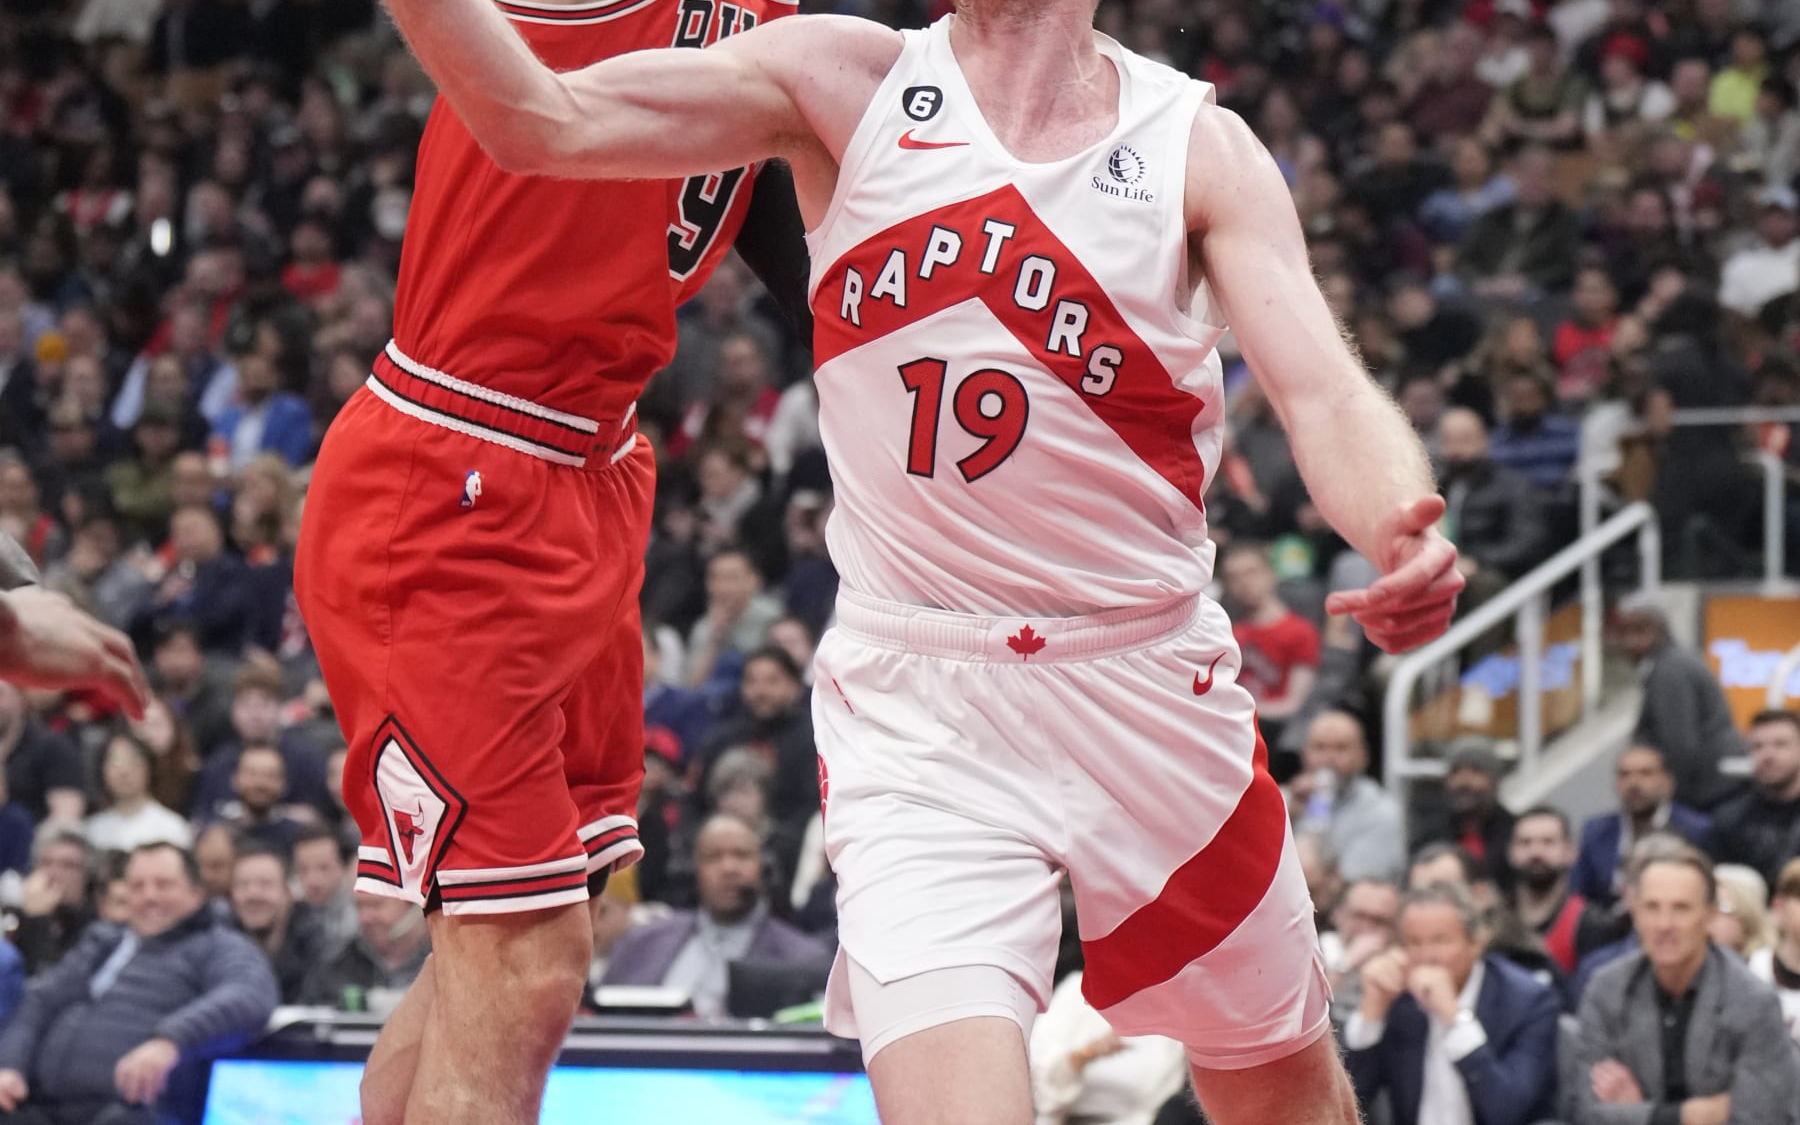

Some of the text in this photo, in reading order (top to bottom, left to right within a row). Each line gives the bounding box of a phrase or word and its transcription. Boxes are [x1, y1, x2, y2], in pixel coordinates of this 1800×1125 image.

[908, 90, 937, 119] 6
[1091, 176, 1154, 203] Sun Life
[840, 218, 1123, 398] RAPTORS
[897, 357, 1030, 484] 19
